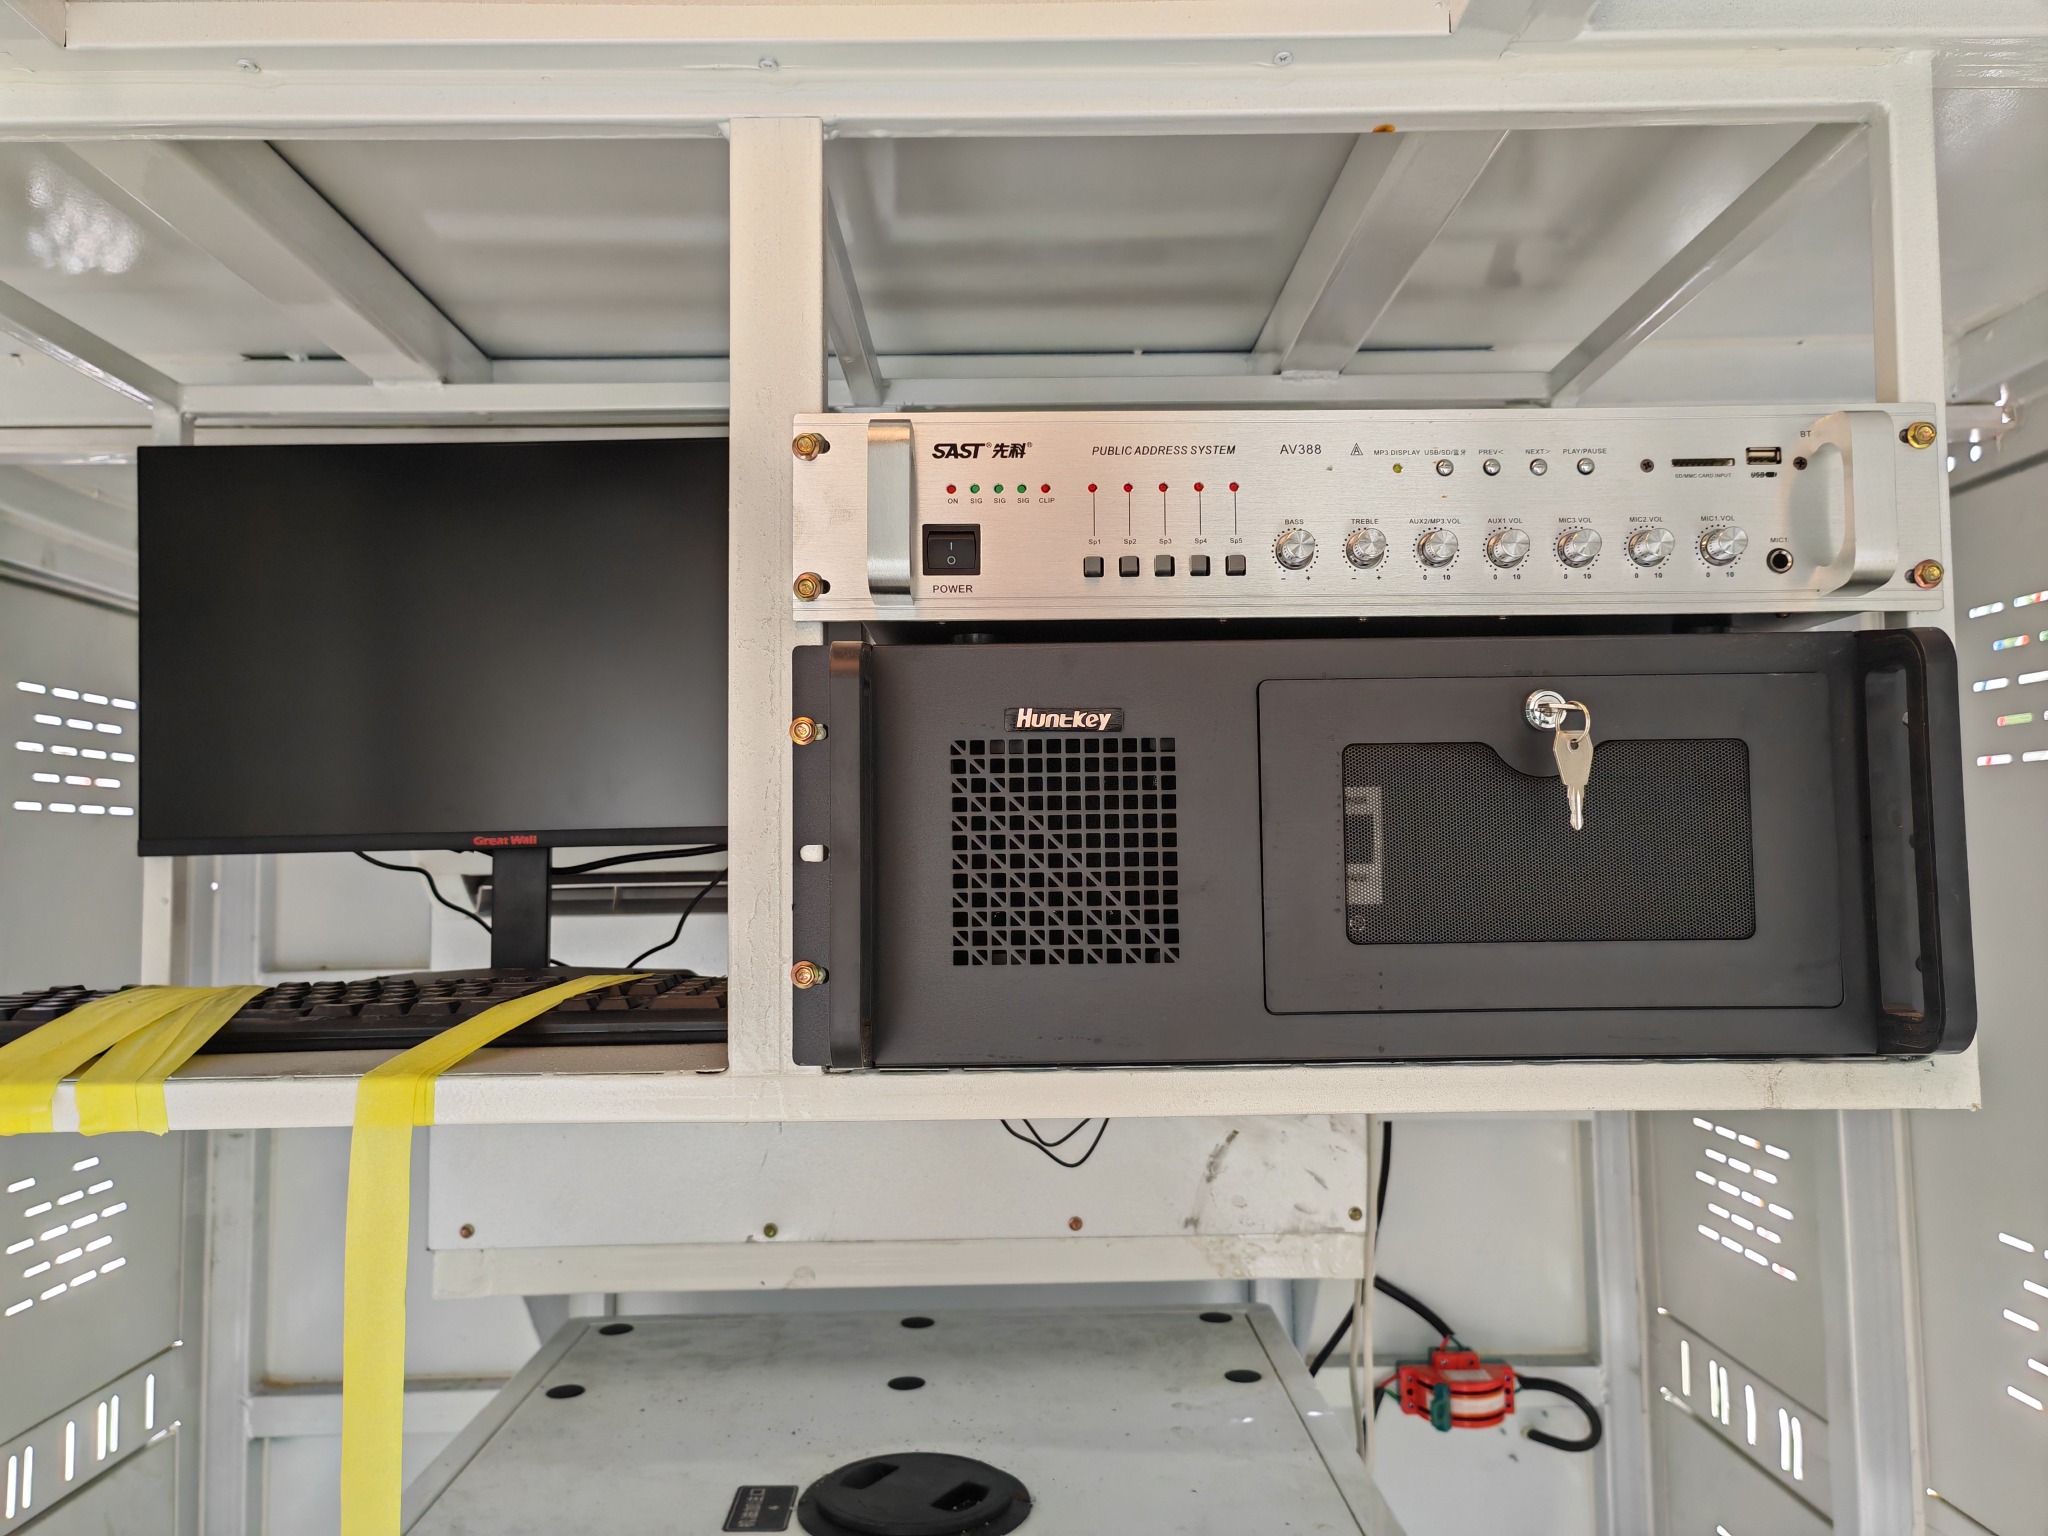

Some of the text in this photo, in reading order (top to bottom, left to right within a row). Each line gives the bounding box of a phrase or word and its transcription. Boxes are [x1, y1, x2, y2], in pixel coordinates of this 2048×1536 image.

[1800, 430, 1812, 438] BT
[1092, 445, 1236, 456] PUBLIC ADDRESS SYSTEM
[1279, 444, 1322, 455] AV388
[932, 584, 974, 594] POWER
[1016, 707, 1112, 731] Huntkey
[473, 835, 538, 846] Great Wall
